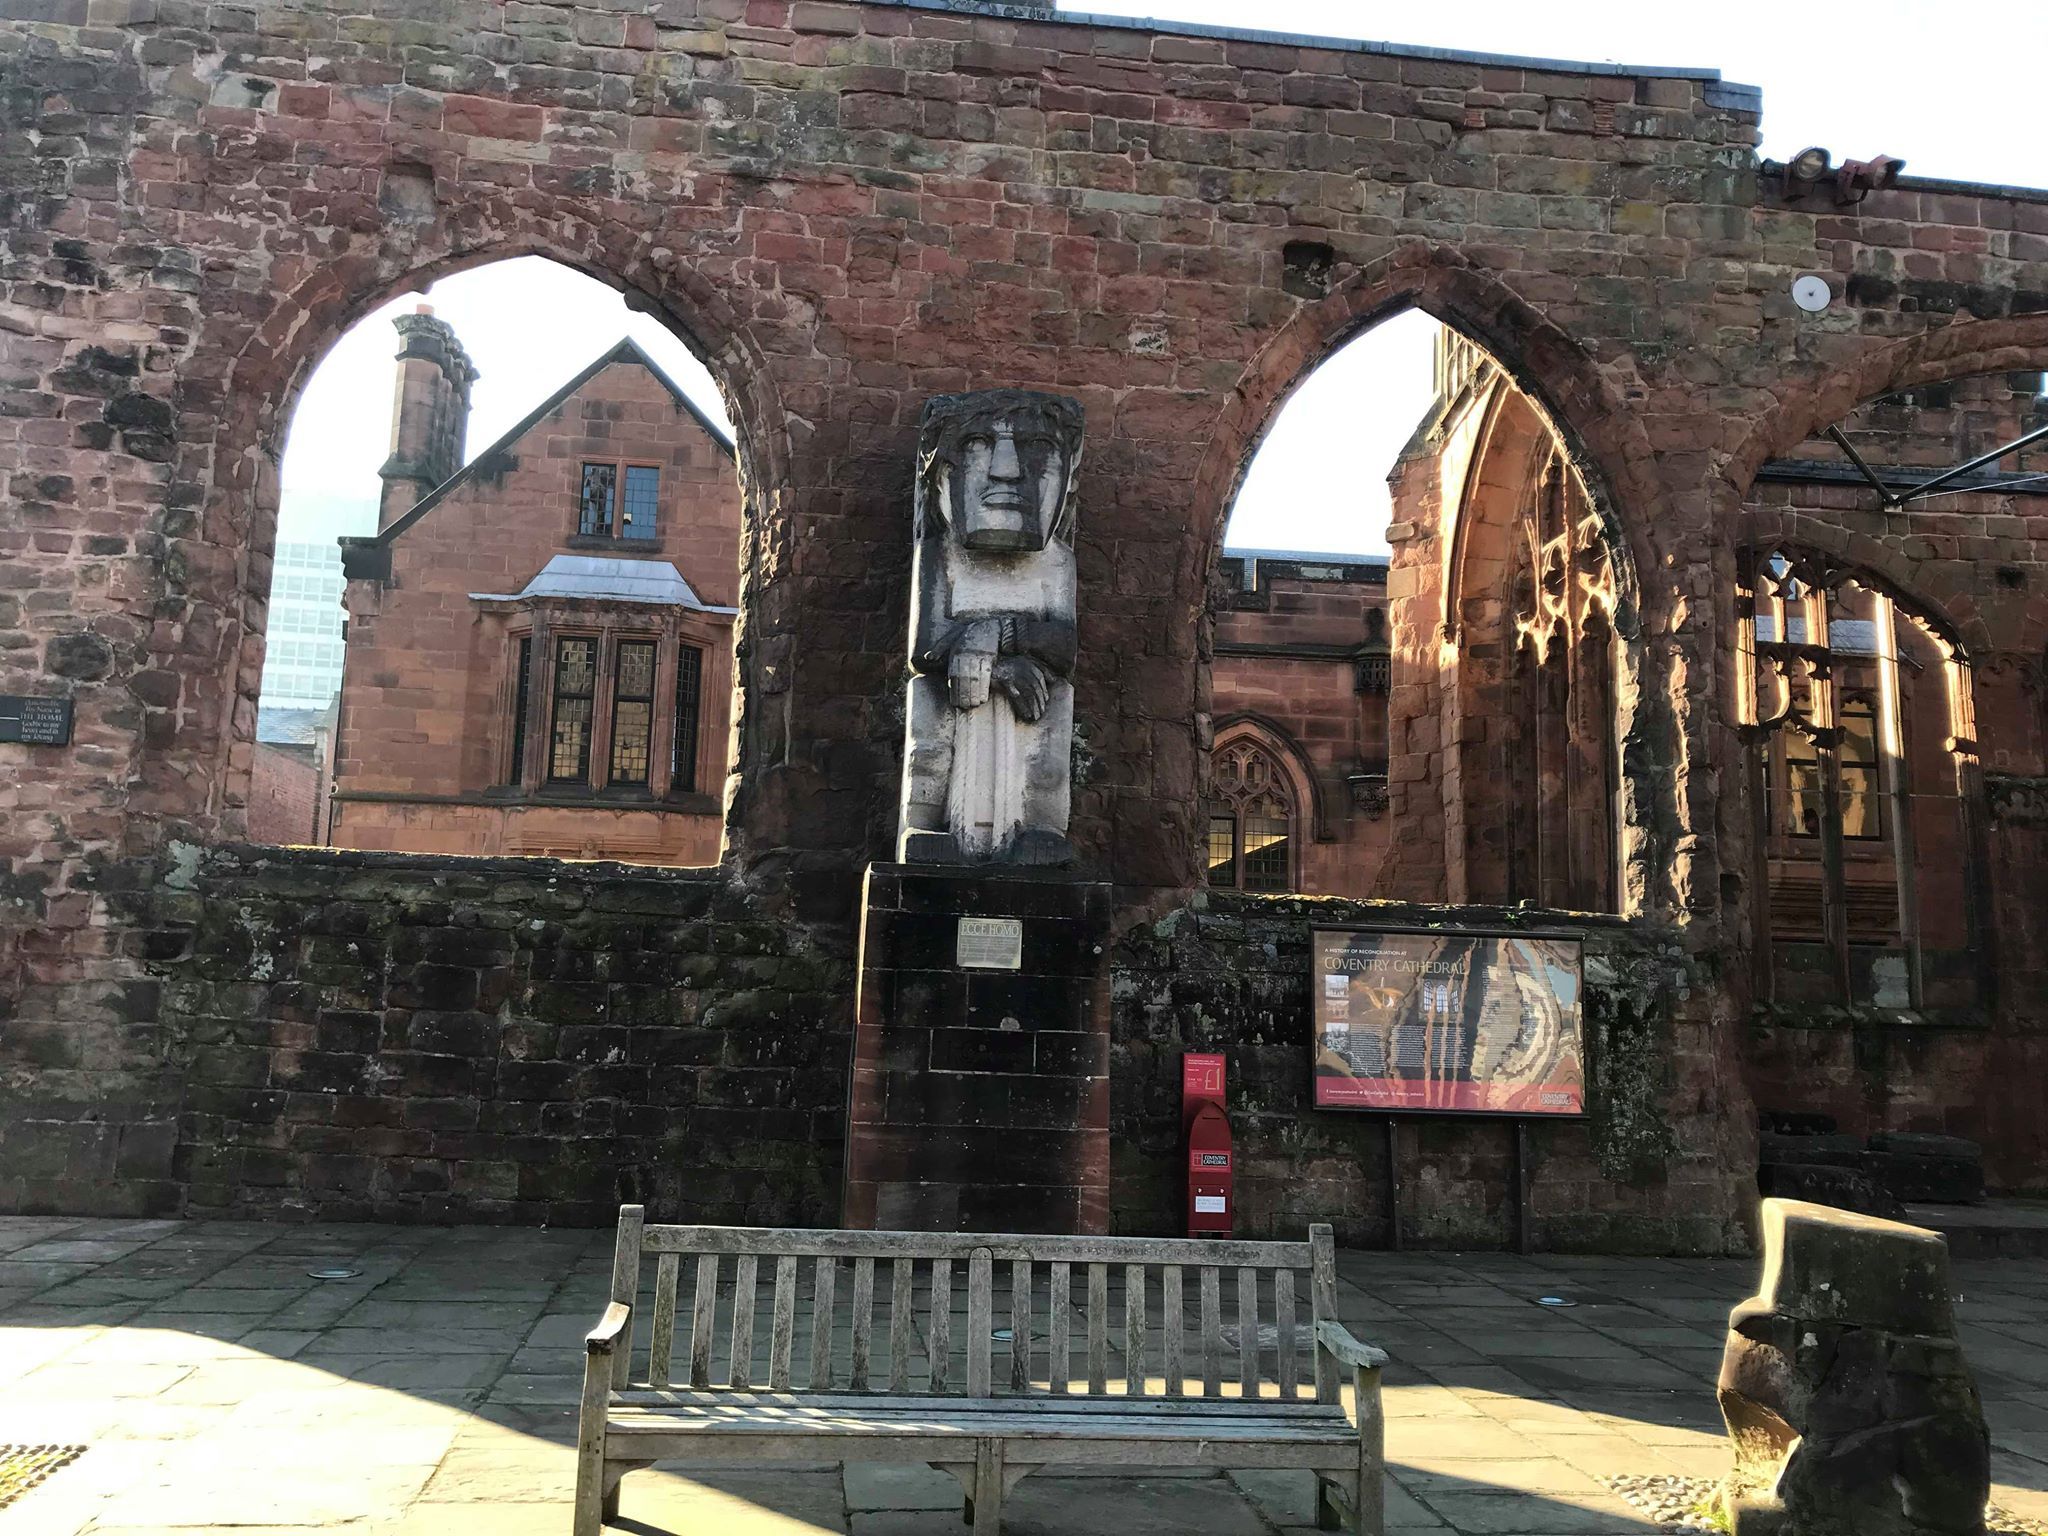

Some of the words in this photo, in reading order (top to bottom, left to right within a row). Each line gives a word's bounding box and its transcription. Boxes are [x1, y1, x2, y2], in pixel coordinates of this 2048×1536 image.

[960, 923, 987, 936] ECCE
[989, 924, 1019, 937] HOMO
[1324, 957, 1390, 971] COVENTRY
[1394, 960, 1466, 975] CATHEDRAL
